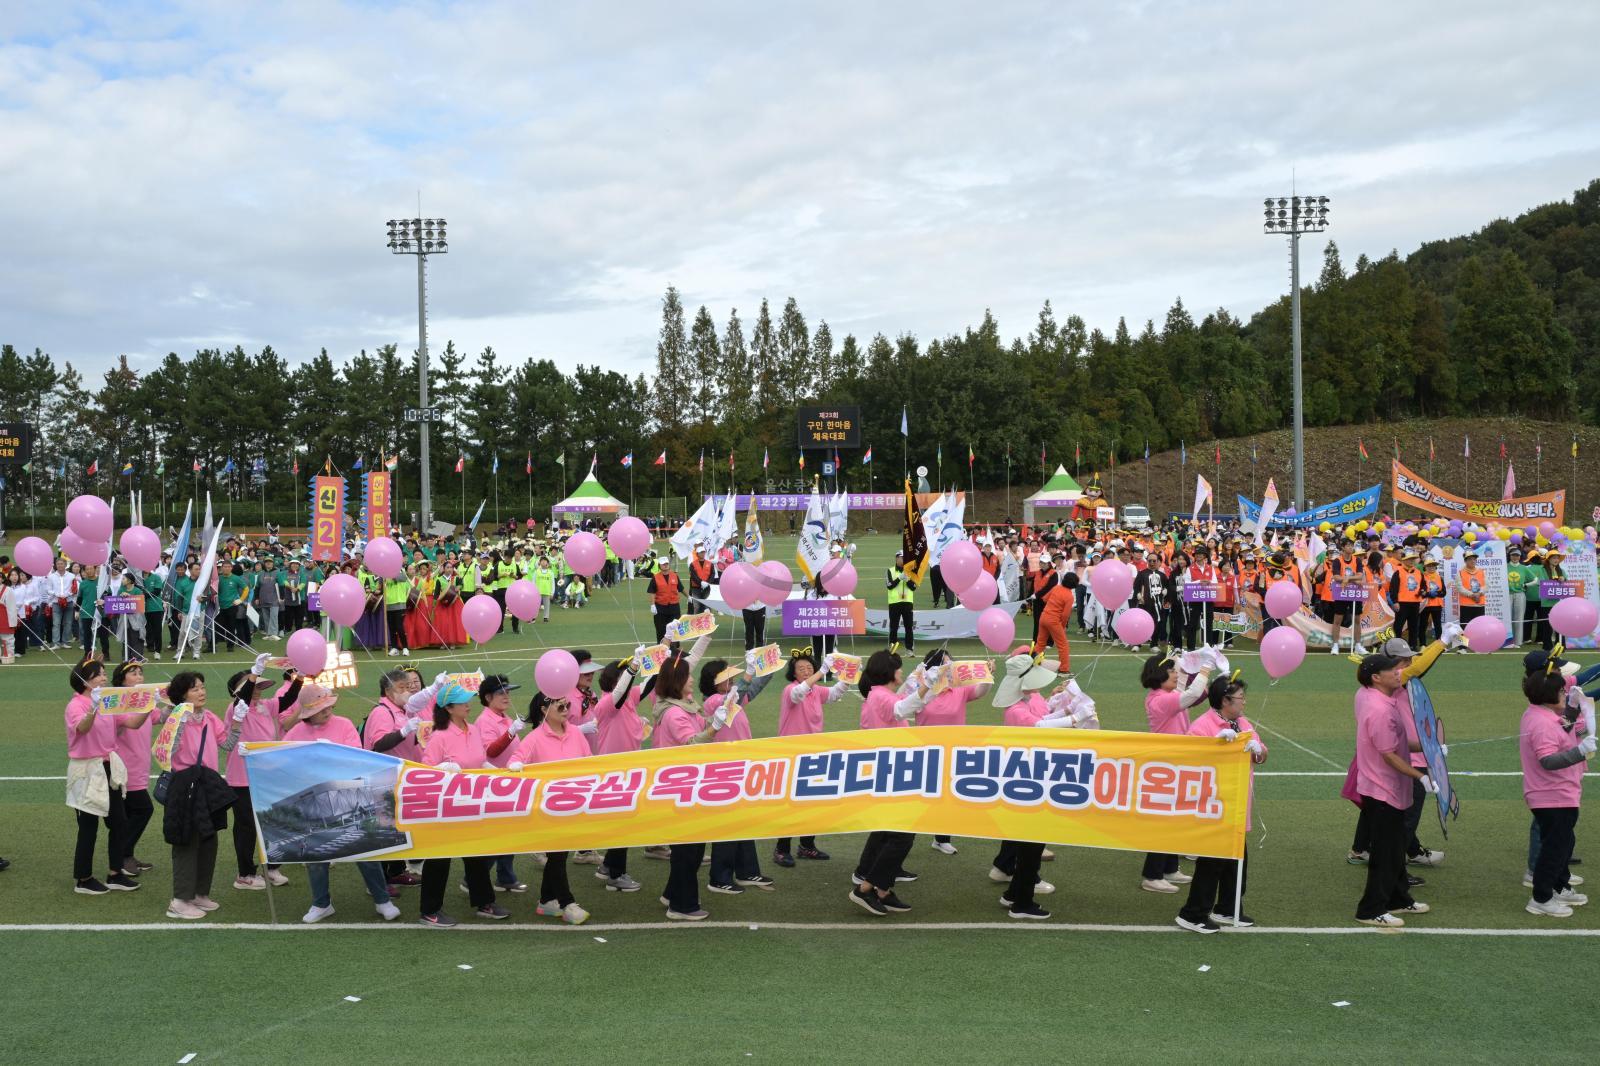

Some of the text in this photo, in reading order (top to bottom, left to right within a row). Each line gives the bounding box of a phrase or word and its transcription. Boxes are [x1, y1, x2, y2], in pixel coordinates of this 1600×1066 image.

[404, 409, 441, 421] 10:26
[808, 421, 852, 430] 구민 한마음
[812, 432, 846, 441] 체육대회
[824, 463, 833, 474] B
[761, 497, 798, 507] 제23회
[1341, 498, 1367, 514] 삼산
[1192, 590, 1217, 599] 신정1동
[1547, 587, 1576, 596] 신정5동
[111, 602, 137, 611] 신정4동
[798, 607, 848, 617] 제23회 구민
[793, 619, 854, 629] 한마음체육대회
[956, 663, 987, 681] 옥동
[401, 748, 1219, 819] 울산의 중심 옥동에 반다비 빙상장이 온다.
